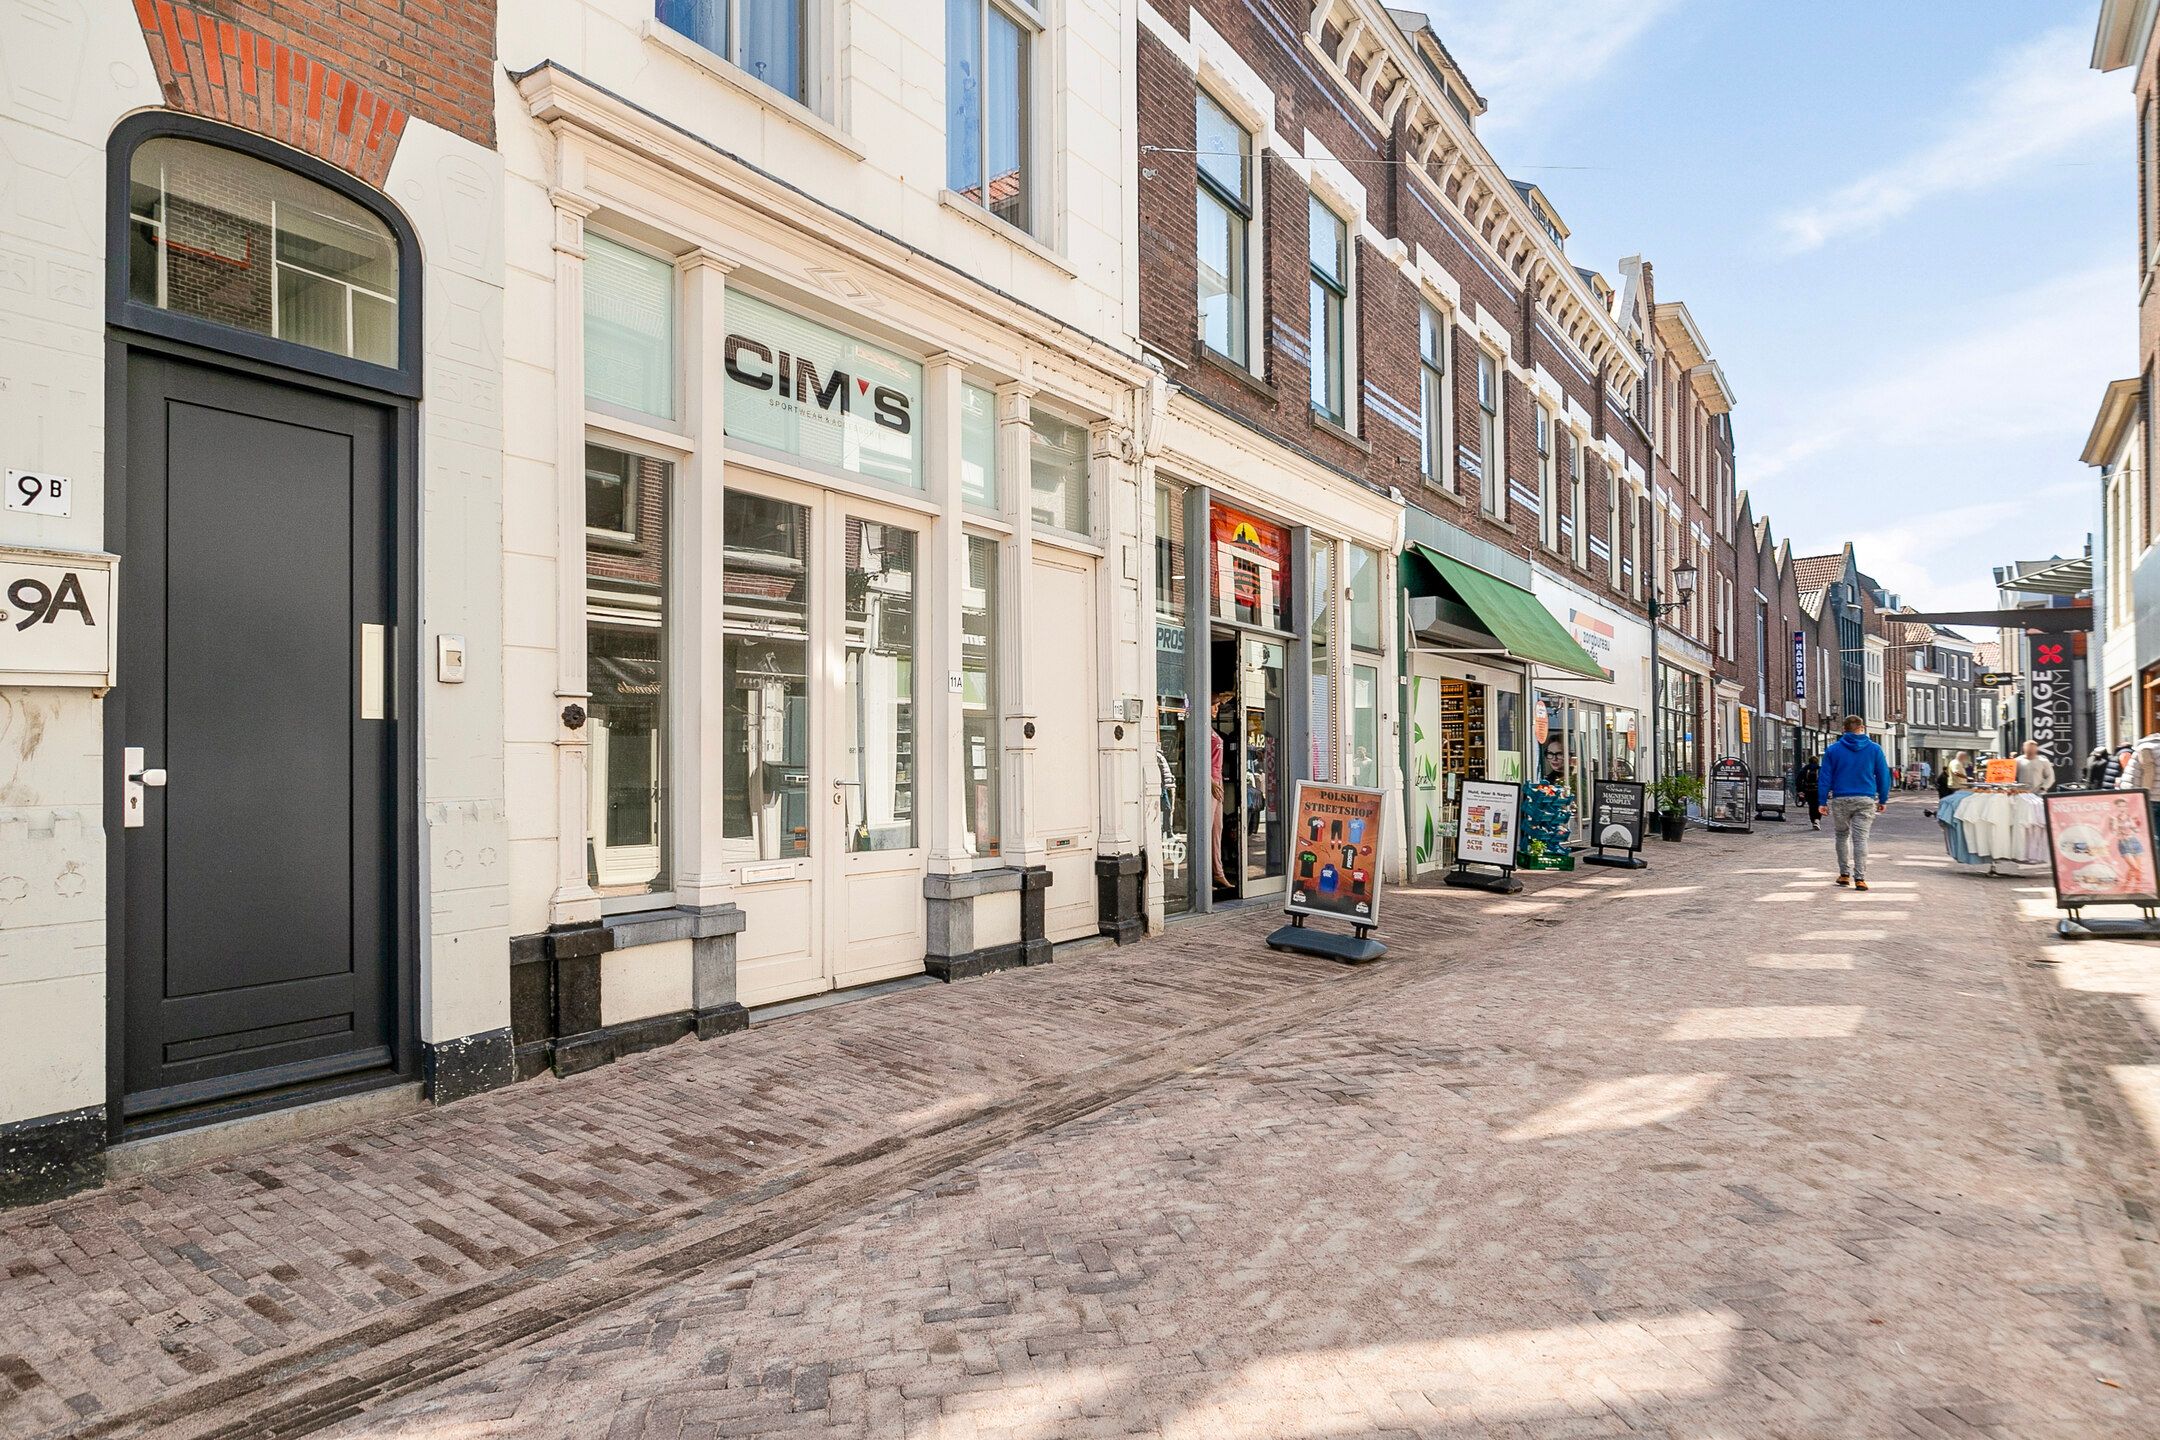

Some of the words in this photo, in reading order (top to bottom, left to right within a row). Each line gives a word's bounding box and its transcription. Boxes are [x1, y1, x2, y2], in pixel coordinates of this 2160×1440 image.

[724, 333, 911, 435] CIM'S
[769, 398, 824, 422] SPORTWEAR
[7, 572, 96, 632] 9A
[950, 676, 963, 688] 11A
[1795, 643, 1804, 695] HANDYMAN
[2032, 669, 2055, 756] ASSAGE
[2051, 669, 2073, 768] SCHIEDAM
[1304, 801, 1373, 818] STREETSHOP
[1320, 790, 1360, 803] POLSKI
